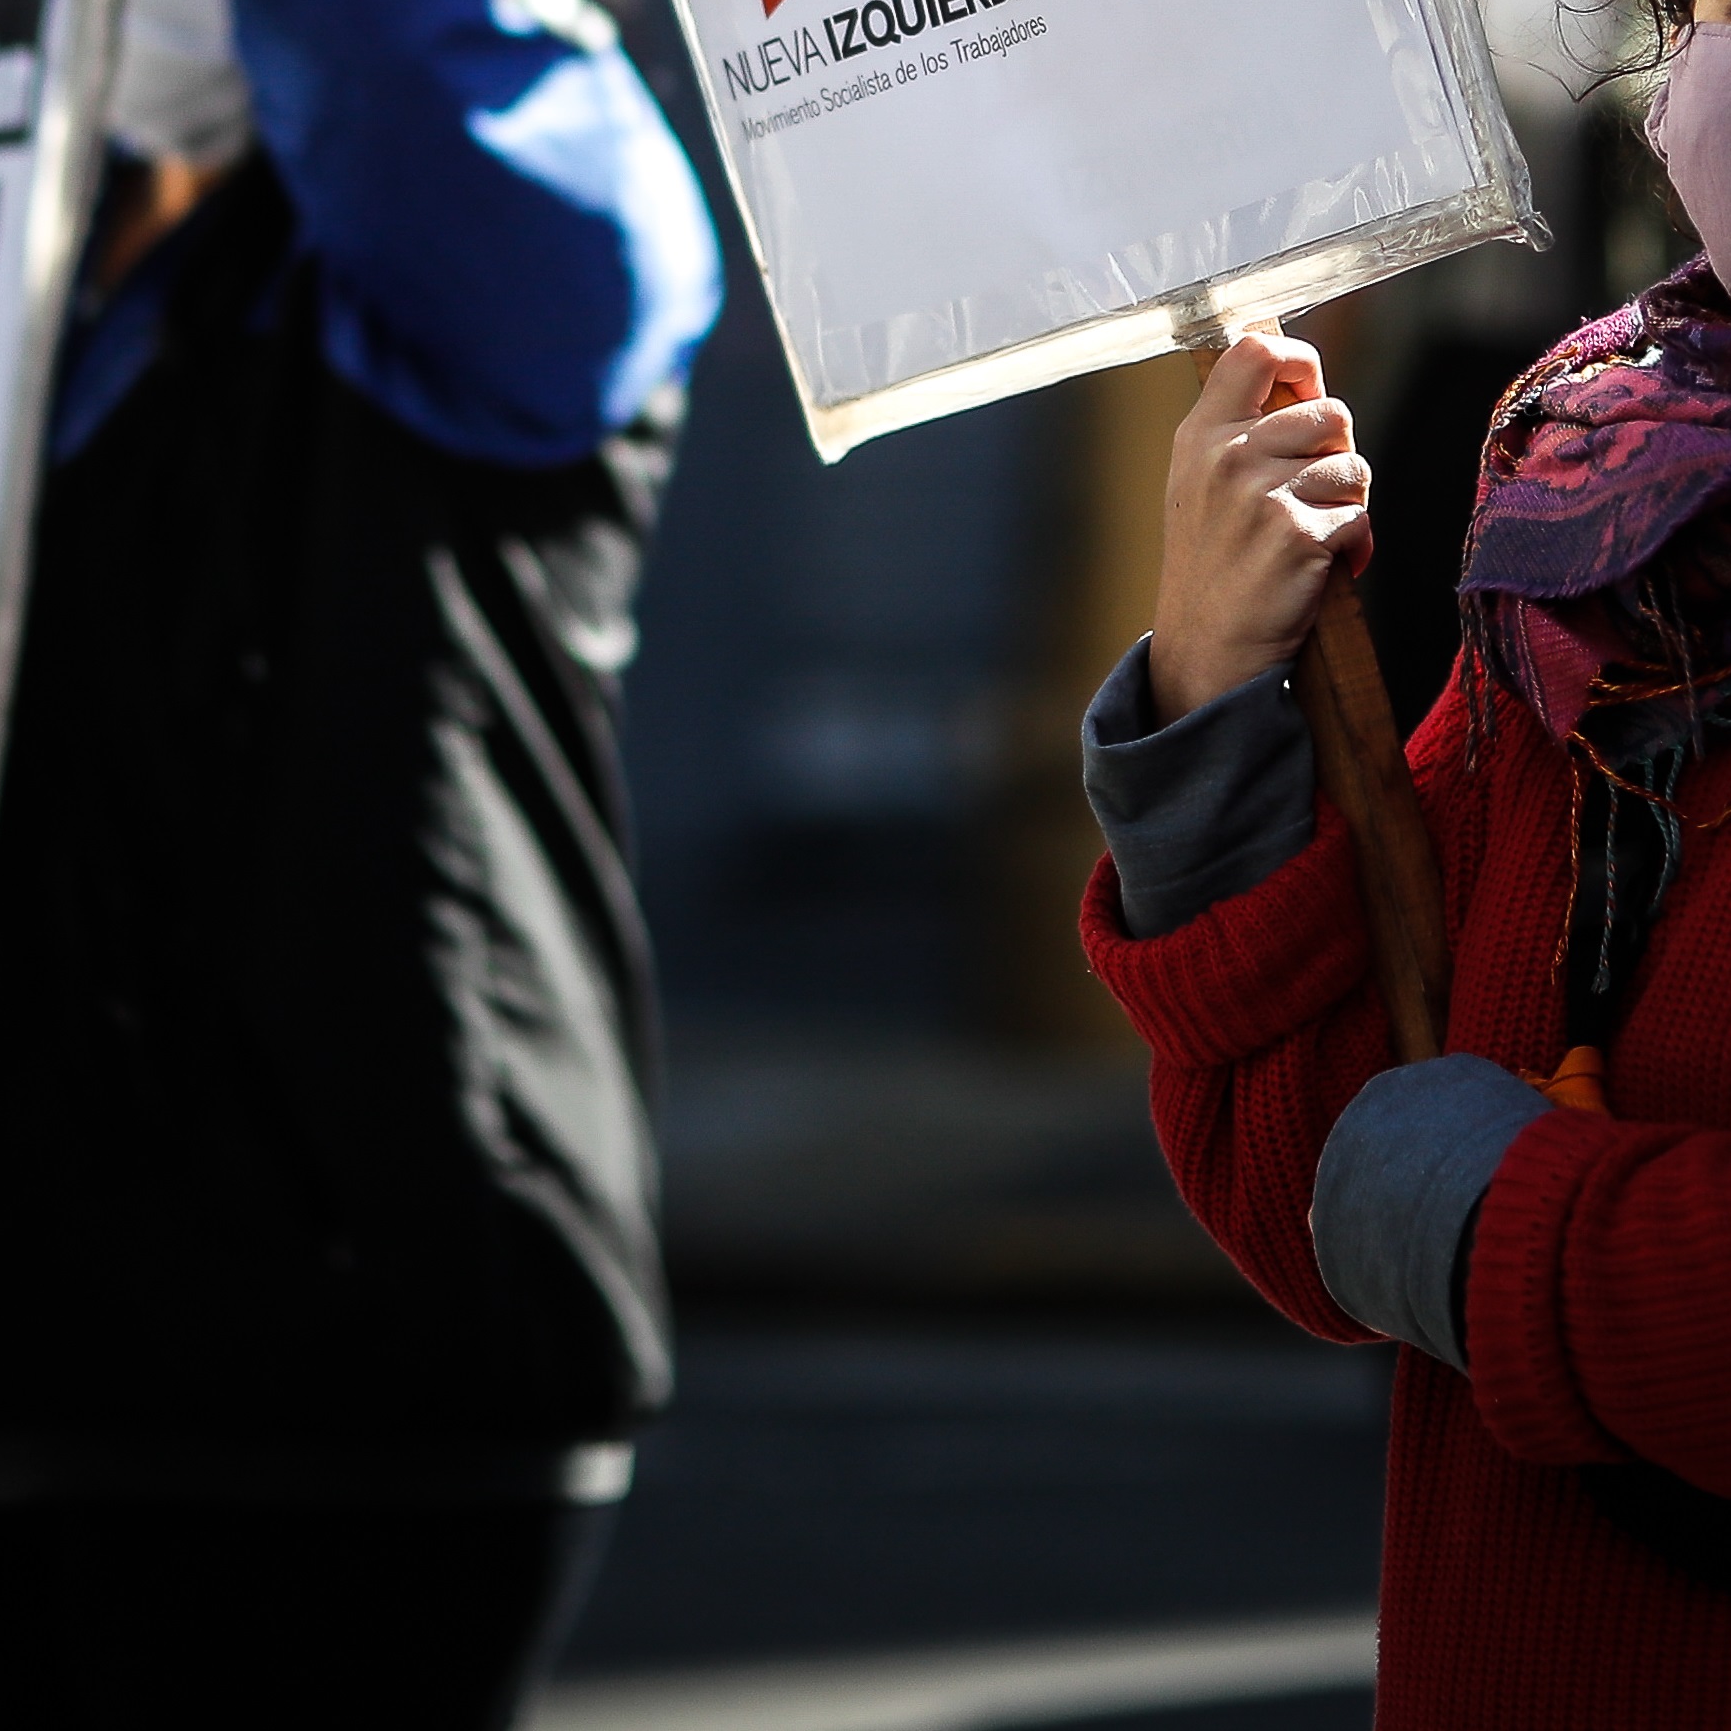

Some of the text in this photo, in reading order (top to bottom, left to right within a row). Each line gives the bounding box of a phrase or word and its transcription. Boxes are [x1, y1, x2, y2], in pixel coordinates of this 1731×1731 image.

[723, 27, 827, 100] NUEVA
[742, 14, 1047, 143] Movimiento Socialista de los Trabajadores
